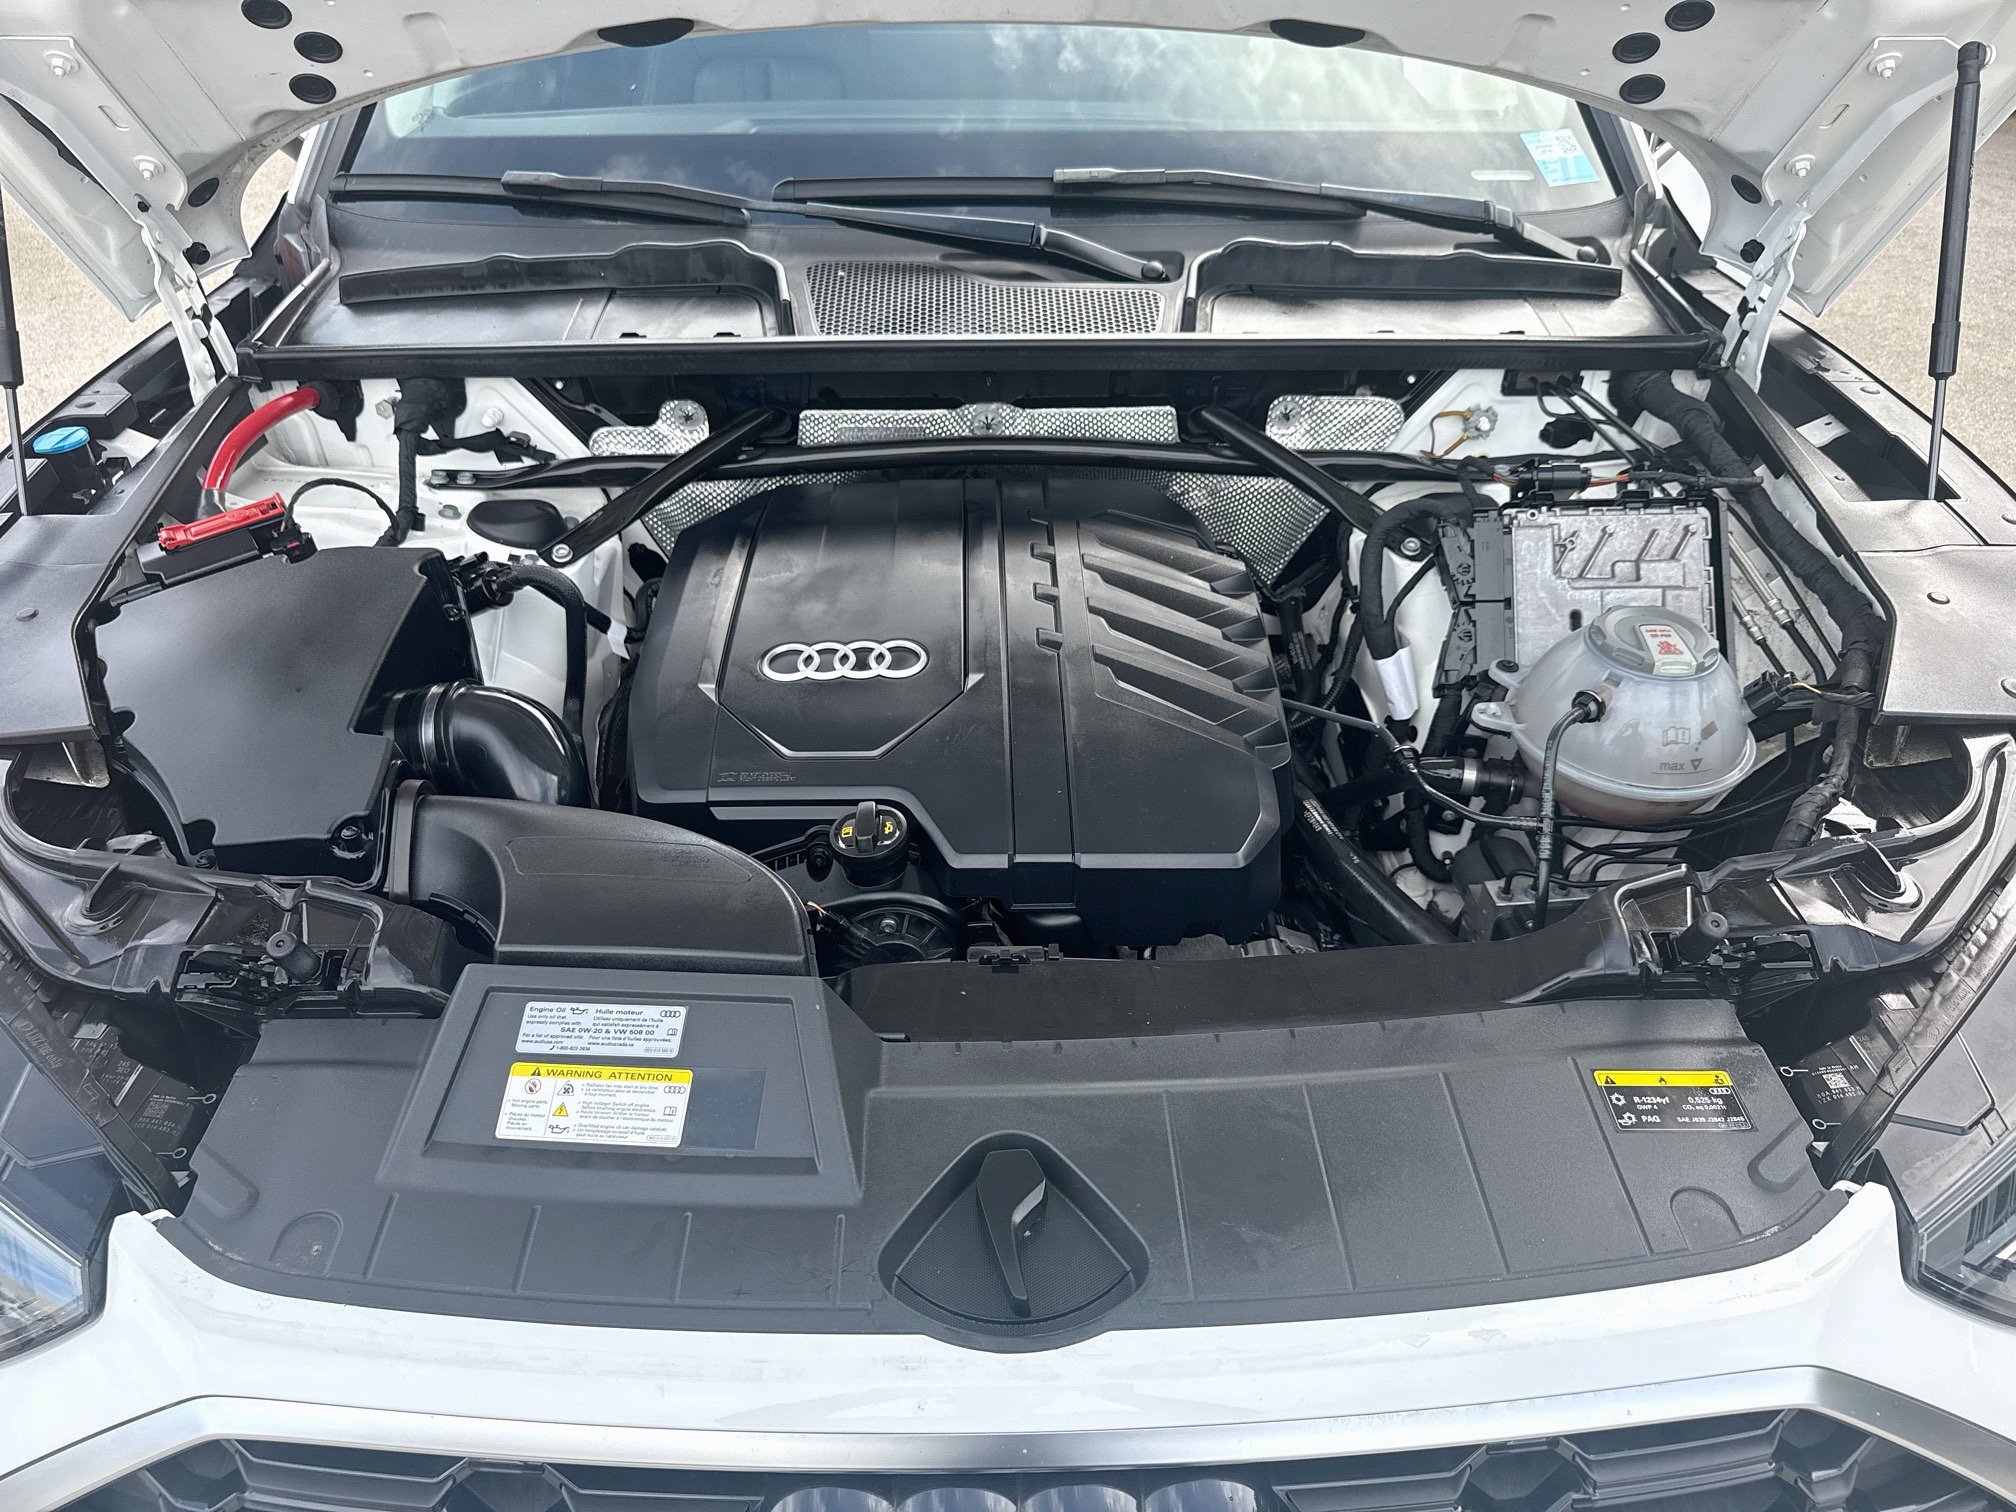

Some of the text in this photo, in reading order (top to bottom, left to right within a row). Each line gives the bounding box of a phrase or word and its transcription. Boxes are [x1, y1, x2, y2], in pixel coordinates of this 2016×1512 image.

[1659, 762, 1685, 771] max
[545, 1068, 672, 1081] WARNING ATTENTION
